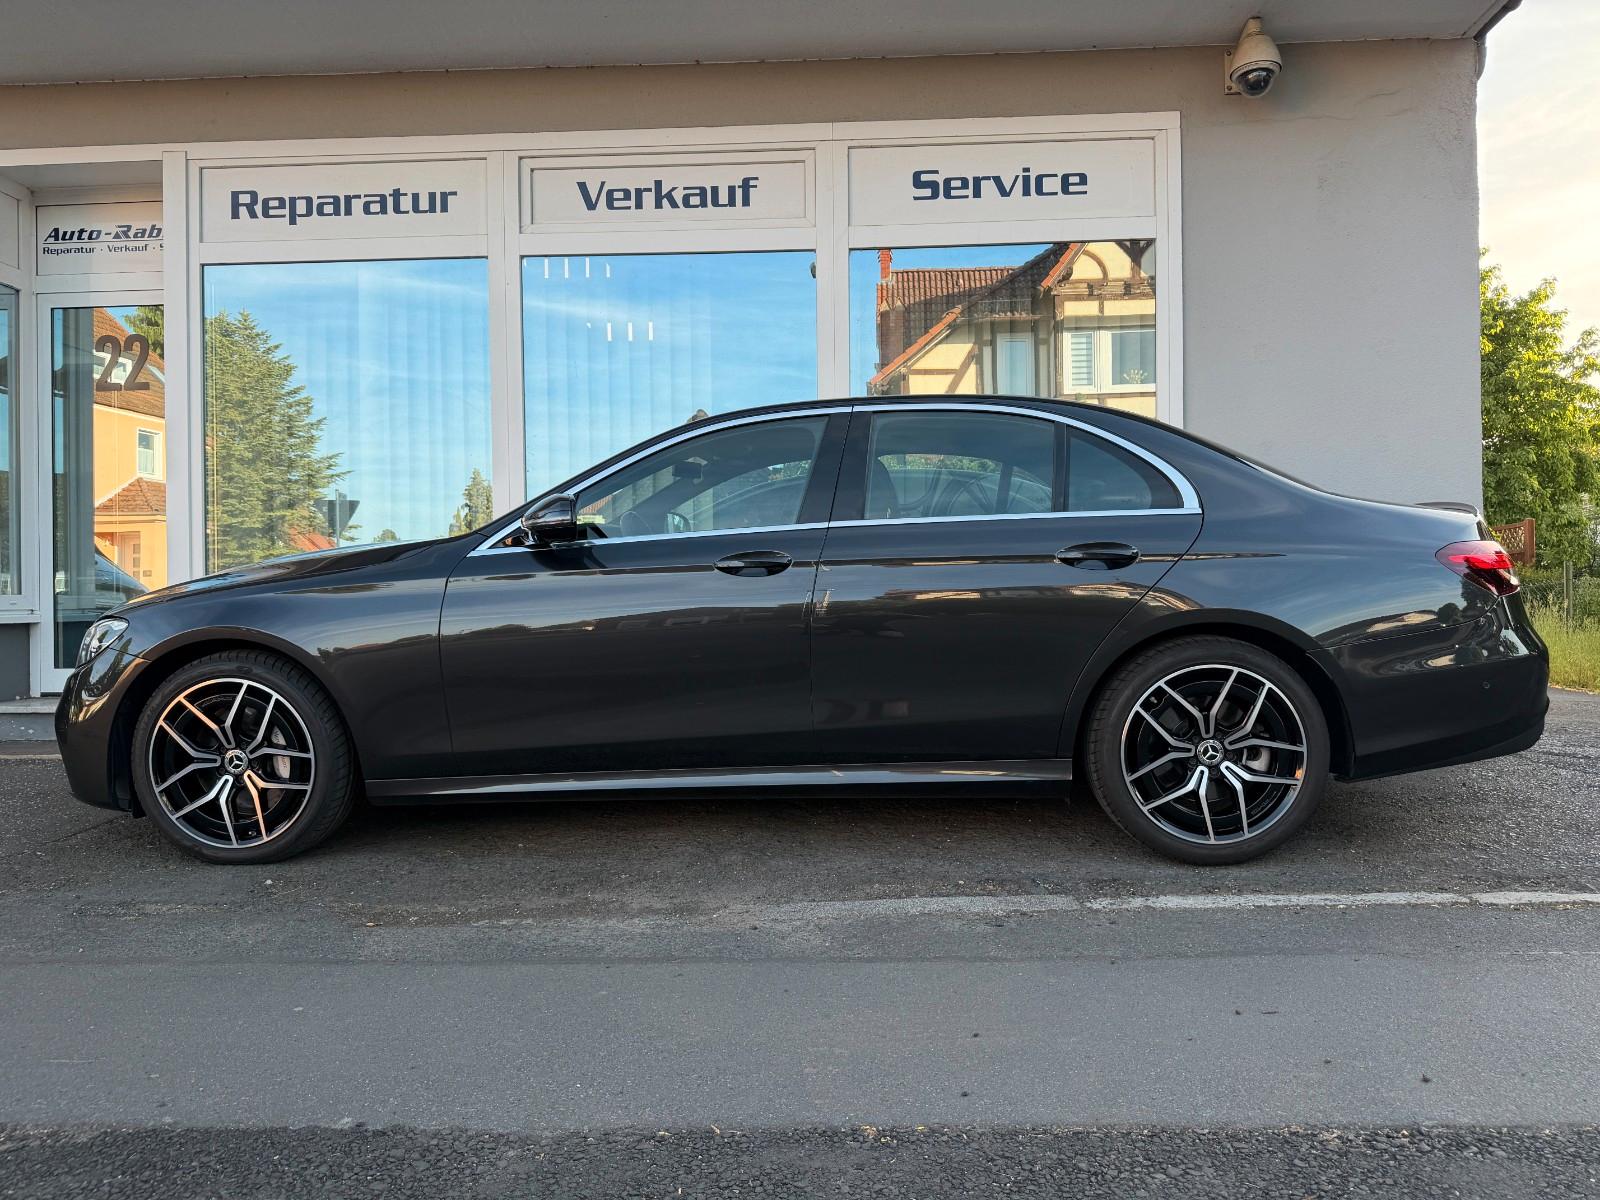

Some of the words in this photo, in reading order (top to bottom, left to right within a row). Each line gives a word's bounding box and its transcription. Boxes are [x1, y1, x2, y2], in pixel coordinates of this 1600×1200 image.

[576, 176, 759, 212] Verkauf
[912, 166, 1089, 201] Service
[230, 187, 458, 226] Reparatur
[42, 246, 97, 256] Reparatur
[106, 243, 150, 253] Verkauf
[44, 224, 164, 242] Auto-Rab
[94, 333, 151, 392] 22
